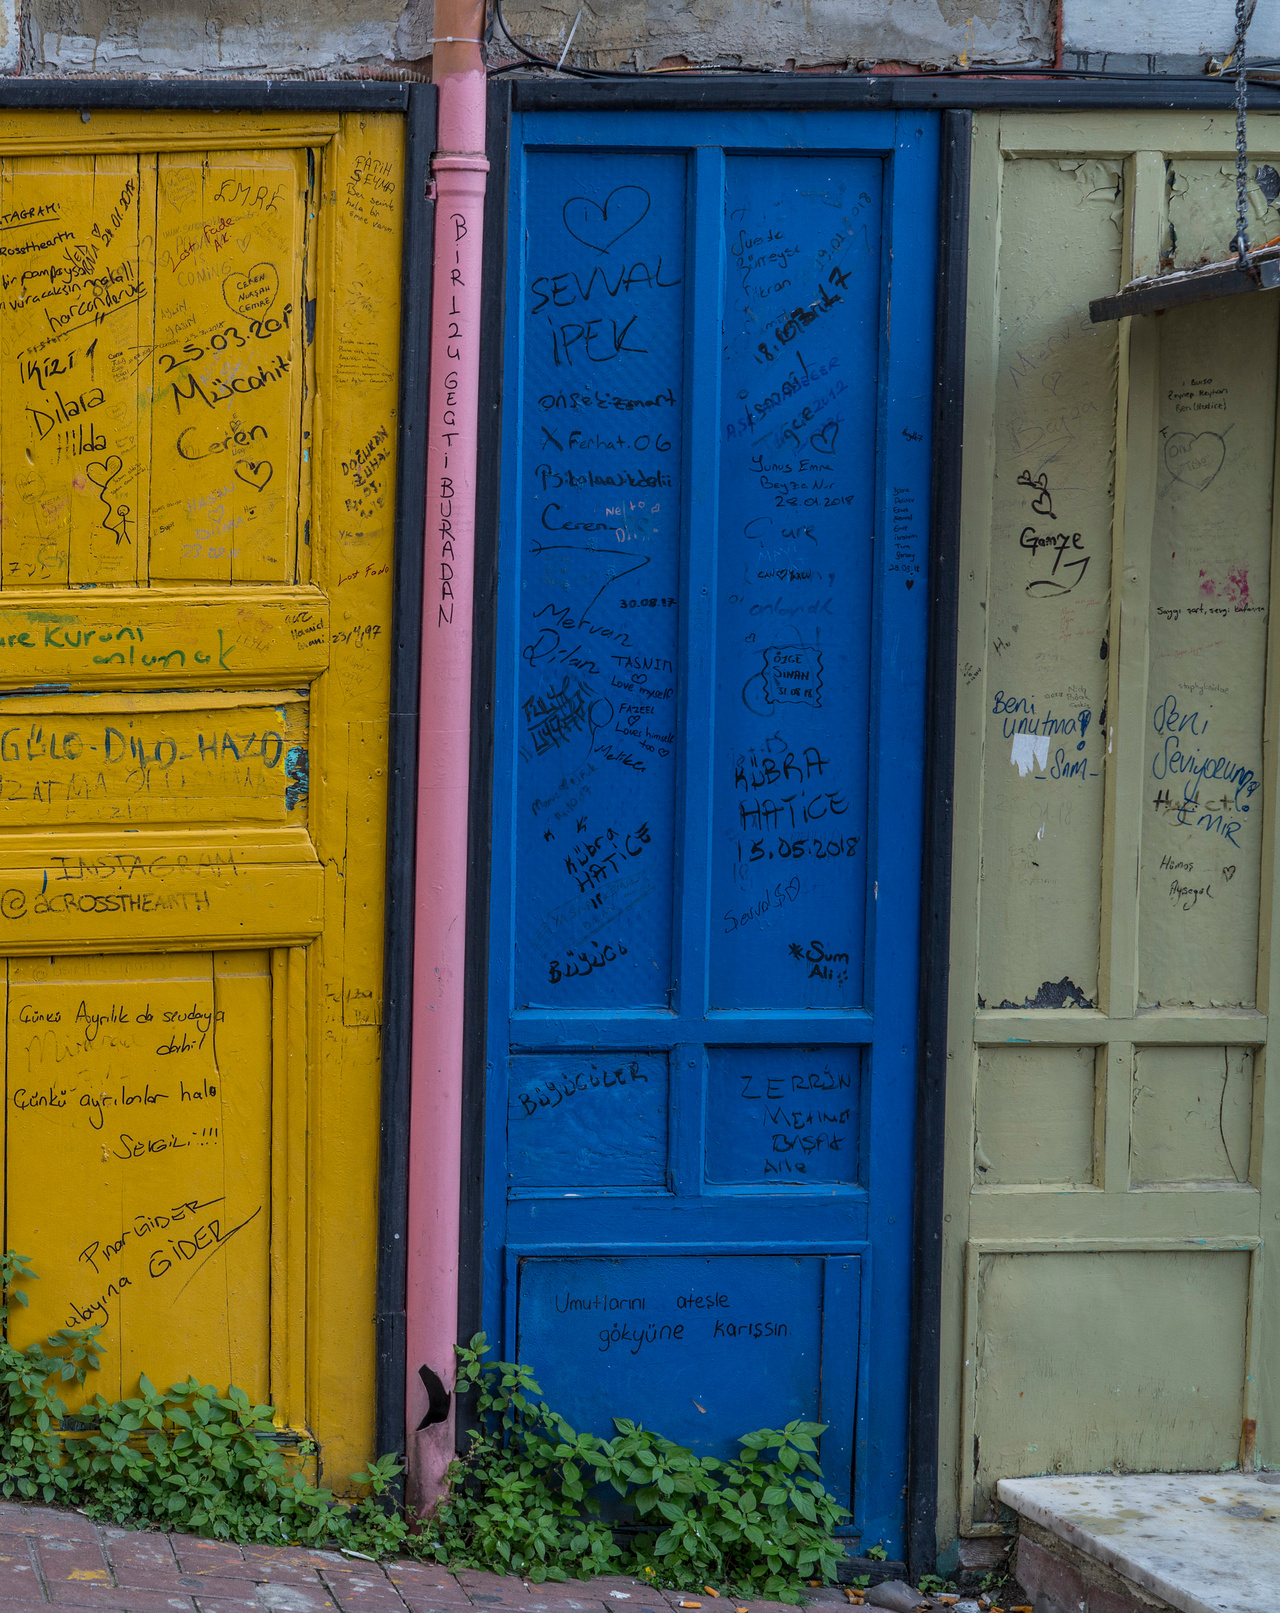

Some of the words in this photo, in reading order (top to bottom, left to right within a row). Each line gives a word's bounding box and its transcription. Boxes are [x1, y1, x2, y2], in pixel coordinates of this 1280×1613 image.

[1, 274, 17, 291] bir
[171, 354, 292, 416] Mücahit
[24, 387, 107, 442] Dilara
[175, 424, 269, 461] Ceren
[797, 458, 834, 473] Emre
[759, 475, 809, 495] Beyza
[540, 502, 620, 532] Ceren
[437, 477, 456, 628] BURADAN
[610, 674, 635, 693] Love
[638, 686, 675, 701] myself
[991, 689, 1036, 716] Beni
[1152, 693, 1215, 737] Seni
[614, 720, 642, 738] Loves
[637, 739, 656, 753] too
[19, 1004, 62, 1024] Çünkü
[135, 1003, 154, 1024] da
[12, 1086, 68, 1111] Çünkü
[179, 1077, 218, 1102] hala
[554, 1291, 646, 1314] Umutlarını
[598, 1321, 686, 1356] gökyüne
